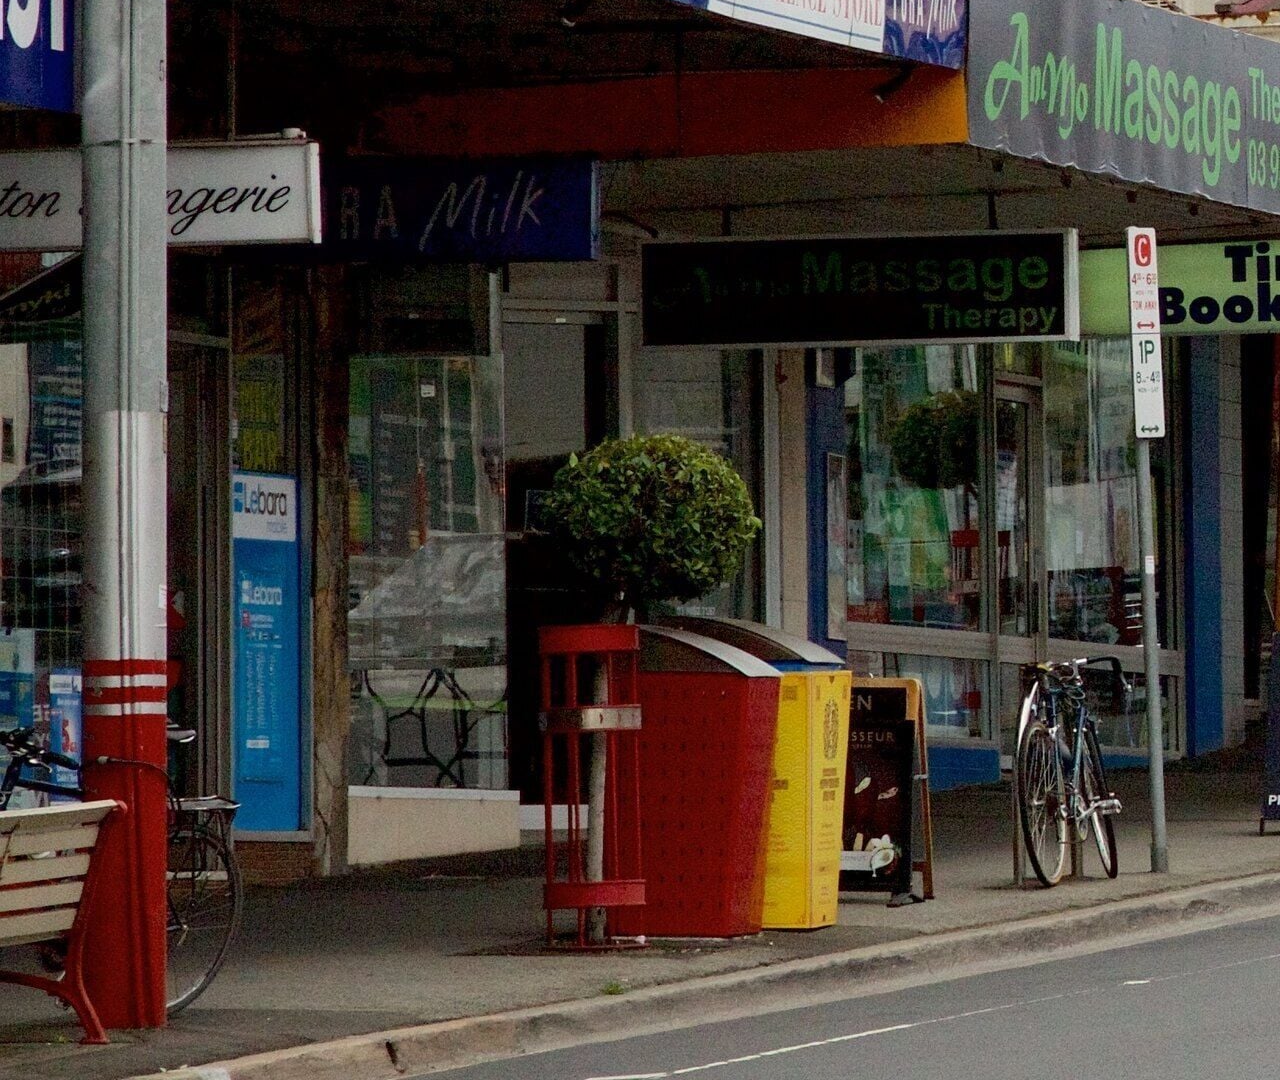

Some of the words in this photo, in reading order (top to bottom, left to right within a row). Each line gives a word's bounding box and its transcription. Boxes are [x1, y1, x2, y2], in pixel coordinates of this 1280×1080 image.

[1094, 22, 1241, 187] Massage
[1248, 139, 1268, 187] 03
[167, 173, 290, 236] ngerie
[418, 170, 545, 253] Milk
[801, 249, 1051, 303] Massage
[921, 302, 1059, 333] Therapy
[1138, 340, 1155, 364] 1P
[244, 482, 288, 516] Lebara
